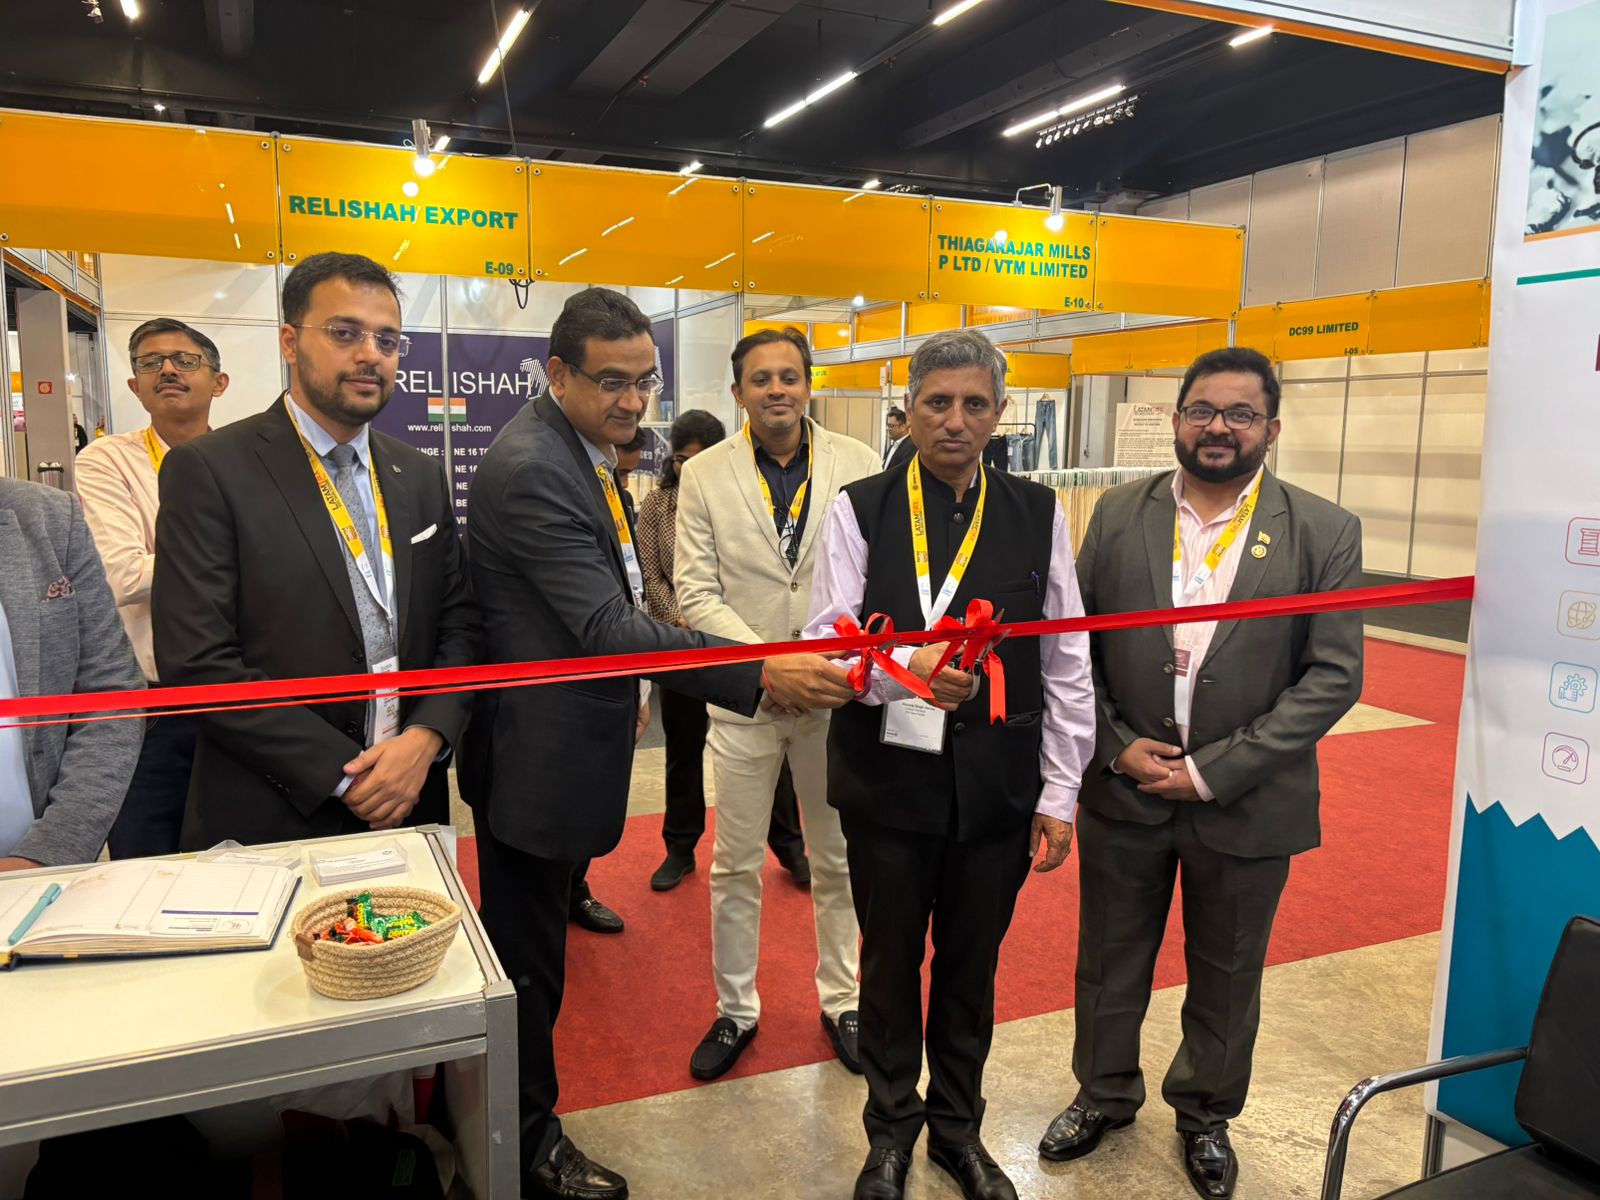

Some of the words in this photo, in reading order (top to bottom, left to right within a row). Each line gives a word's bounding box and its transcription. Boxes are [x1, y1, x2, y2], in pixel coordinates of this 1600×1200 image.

[288, 195, 416, 223] RELISHAH
[425, 206, 519, 230] EXPORT
[937, 234, 1044, 257] THIAGARAJAR
[1048, 243, 1091, 260] MILLS
[485, 261, 514, 276] E-09
[938, 255, 948, 270] P
[953, 256, 982, 272] LTD
[985, 258, 990, 273] /
[994, 259, 1025, 275] VTM
[1030, 261, 1089, 279] LIMITED
[1064, 296, 1084, 309] E-10
[1288, 325, 1314, 337] DC99
[1316, 321, 1359, 335] LIMITED
[394, 370, 532, 395] RELISHAH
[407, 423, 492, 432] www.relishah.com
[416, 447, 439, 456] NGE
[453, 447, 466, 456] NE
[468, 447, 478, 456] 16
[454, 465, 467, 473] NE
[455, 482, 468, 490] NE
